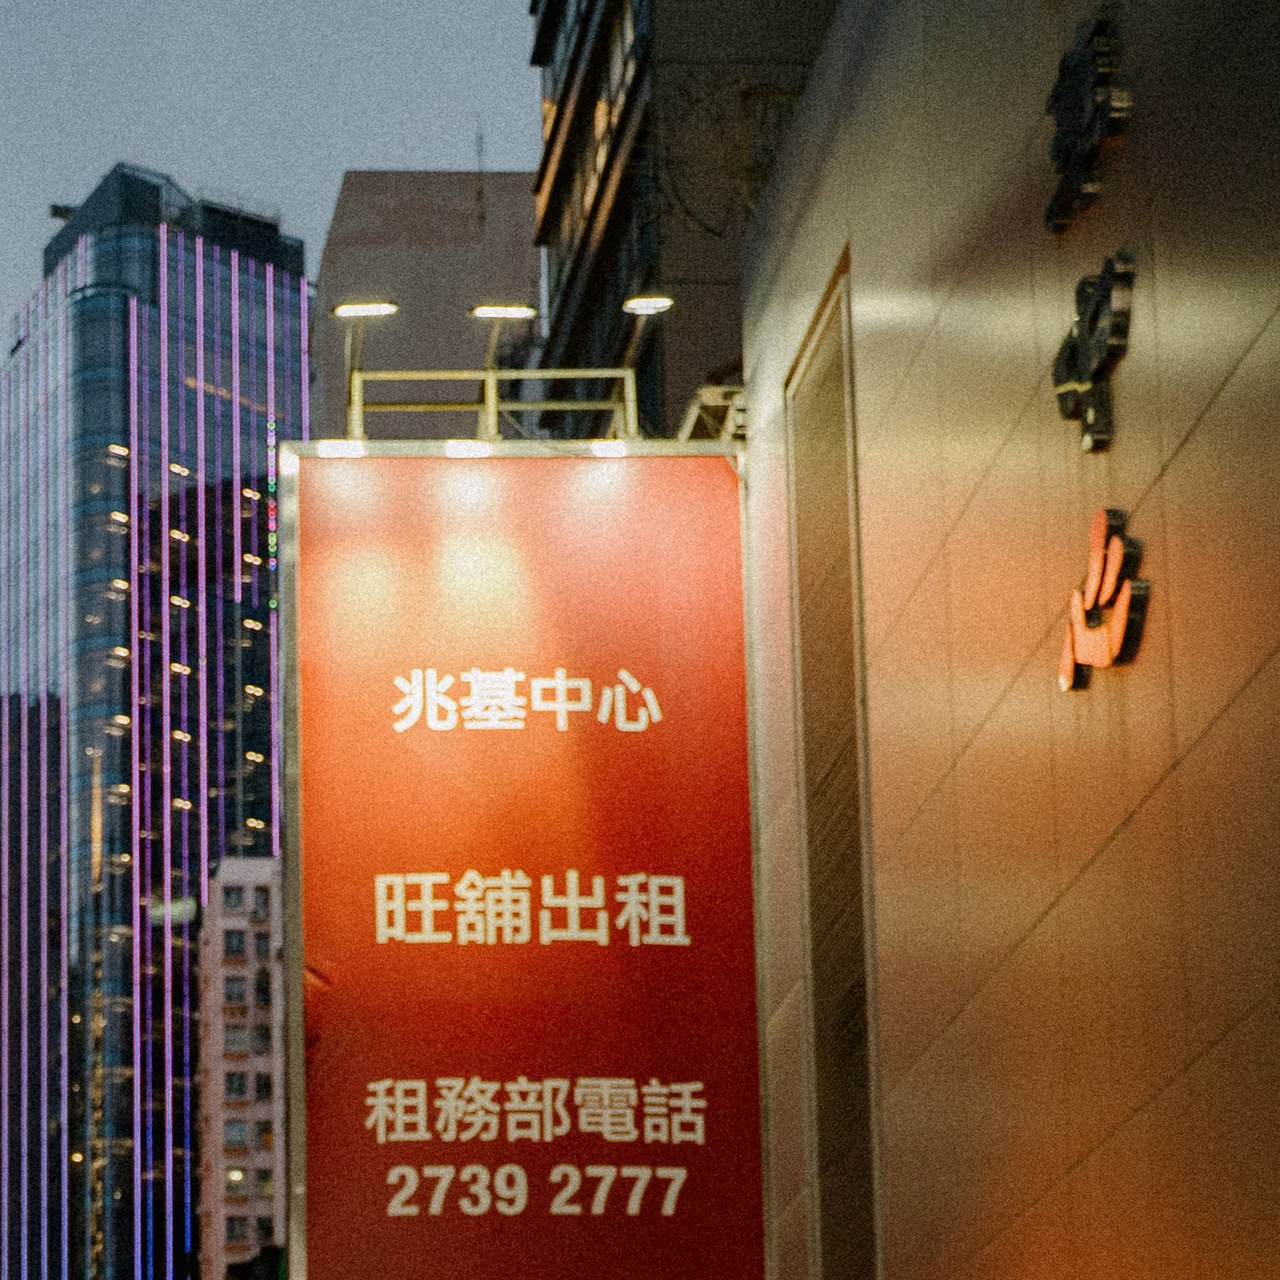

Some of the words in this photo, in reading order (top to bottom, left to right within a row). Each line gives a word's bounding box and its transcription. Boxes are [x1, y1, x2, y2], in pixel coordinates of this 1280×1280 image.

[390, 666, 663, 733] 兆基中心
[373, 869, 691, 947] 旺舖出租
[364, 1075, 707, 1146] 租務部電話
[385, 1163, 529, 1217] 2739
[548, 1164, 689, 1217] 2777
